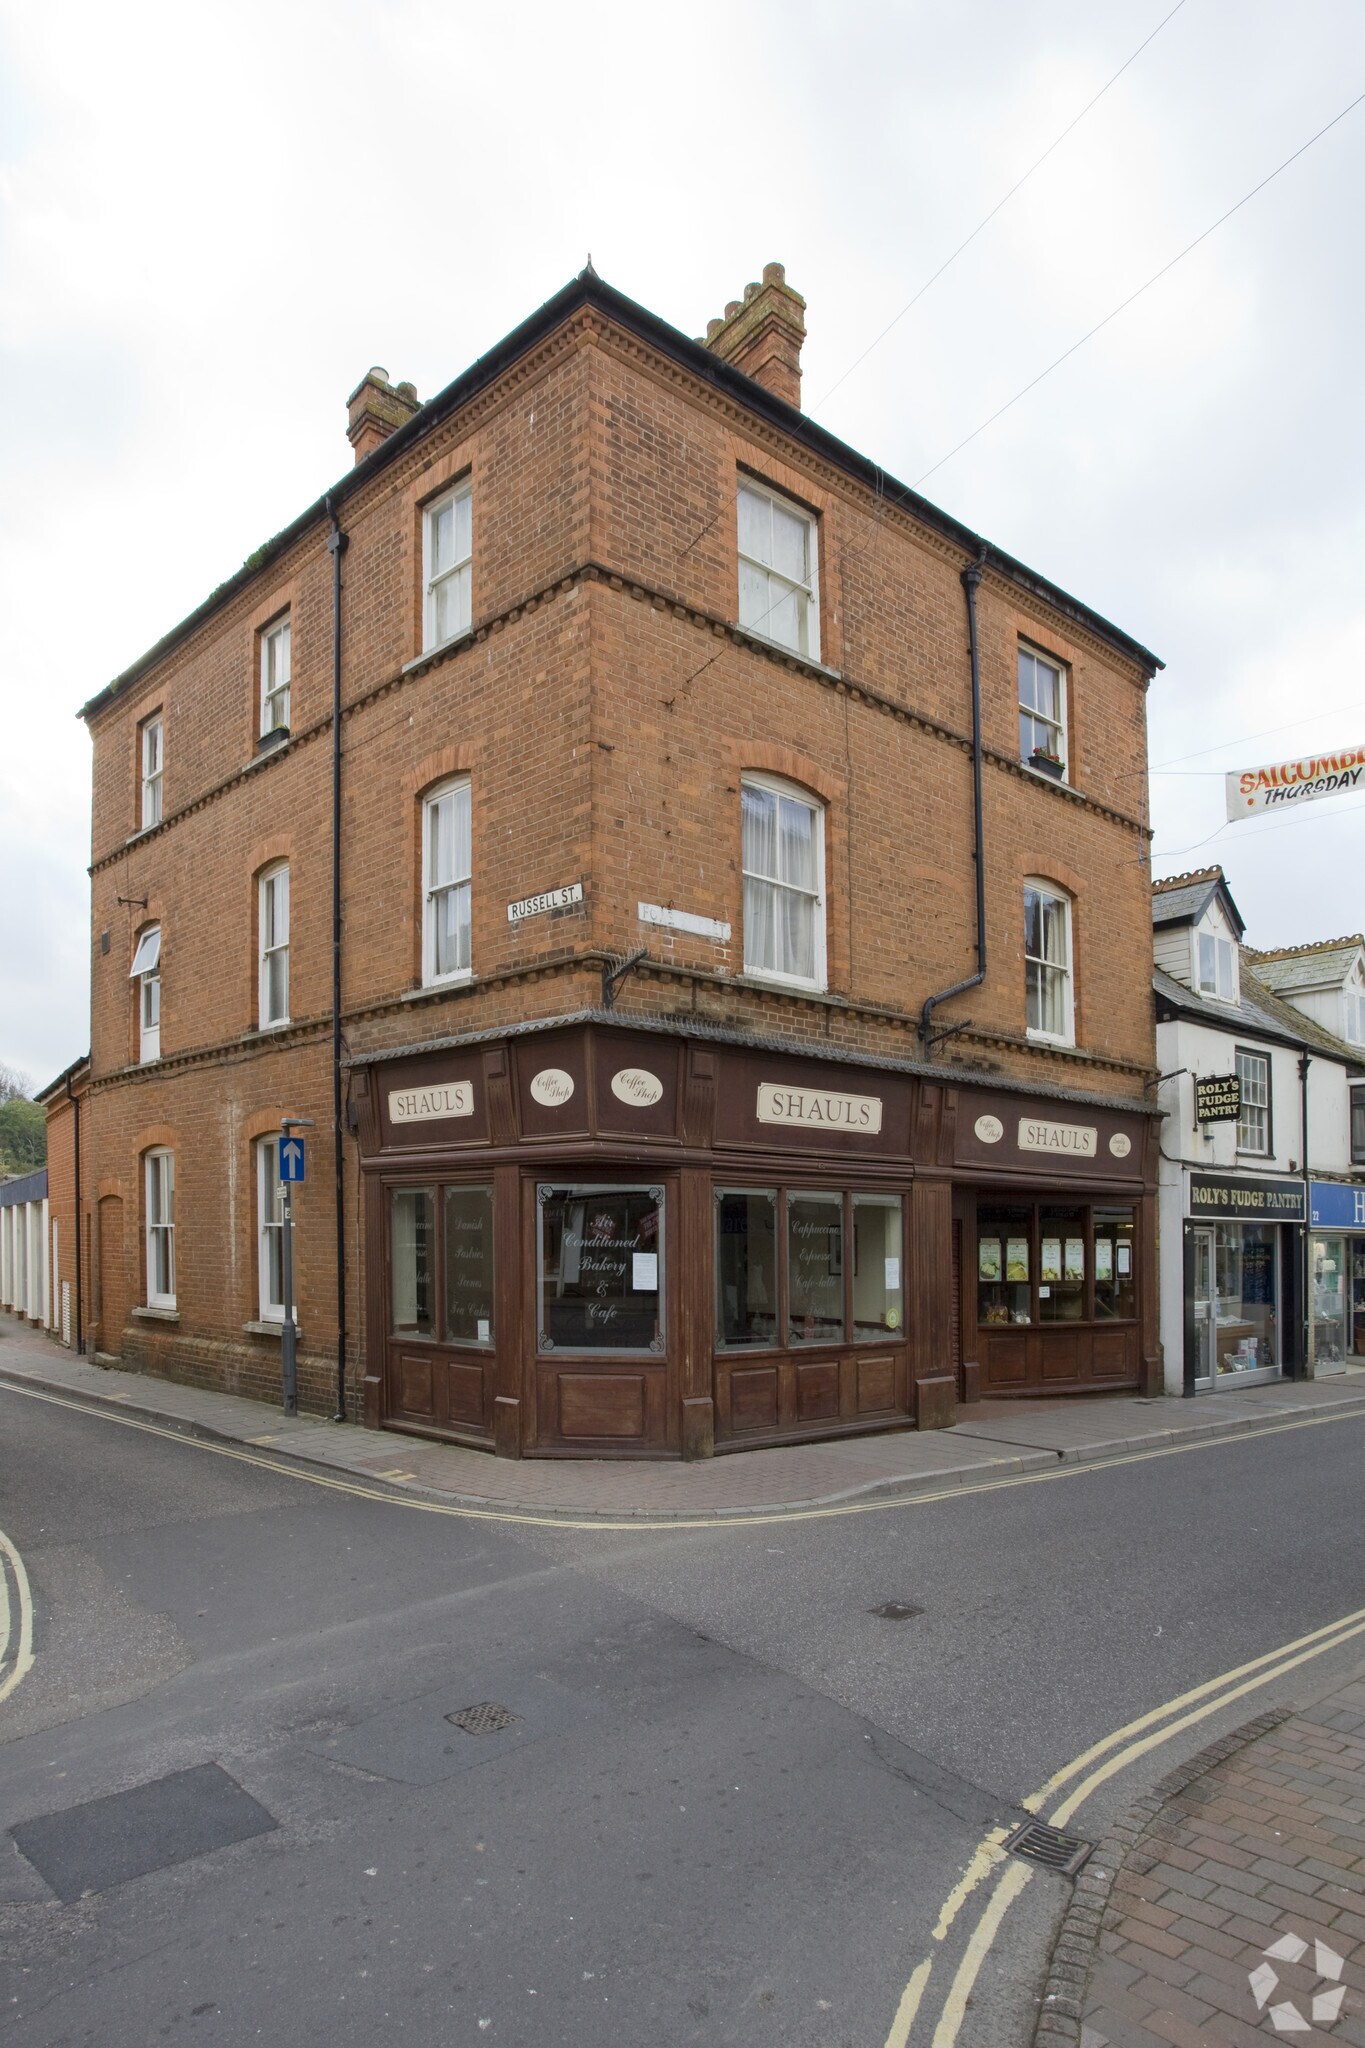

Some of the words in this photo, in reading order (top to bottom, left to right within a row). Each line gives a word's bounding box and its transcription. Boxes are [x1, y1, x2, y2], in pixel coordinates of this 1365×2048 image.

[1264, 767, 1363, 805] THURSDAY
[511, 894, 558, 918] RUSSELL
[561, 887, 579, 903] ST.
[535, 1074, 559, 1091] Coffee
[619, 1072, 647, 1089] Coffee
[1197, 1079, 1240, 1095] ROLY'S
[549, 1085, 571, 1101] Shop
[633, 1086, 658, 1102] Shop
[1198, 1093, 1240, 1106] FUDGE
[396, 1087, 465, 1117] SHAULS
[771, 1091, 871, 1126] SHAULS
[1198, 1104, 1239, 1117] PANTRY
[1026, 1125, 1090, 1151] SHAULS
[1192, 1187, 1228, 1205] ROLY'S
[1230, 1189, 1264, 1207] FUDGE
[1266, 1192, 1302, 1209] PANTRY
[590, 1213, 615, 1228] Air
[1312, 1210, 1320, 1221] 22
[791, 1220, 839, 1239] Cappuccino
[563, 1232, 640, 1248] Conditioned
[799, 1247, 832, 1266] Espresso
[578, 1255, 627, 1277] Bakery
[596, 1280, 609, 1297] &
[794, 1274, 837, 1294] Cafe-latte
[450, 1301, 464, 1315] Tea
[588, 1302, 618, 1325] Cafe
